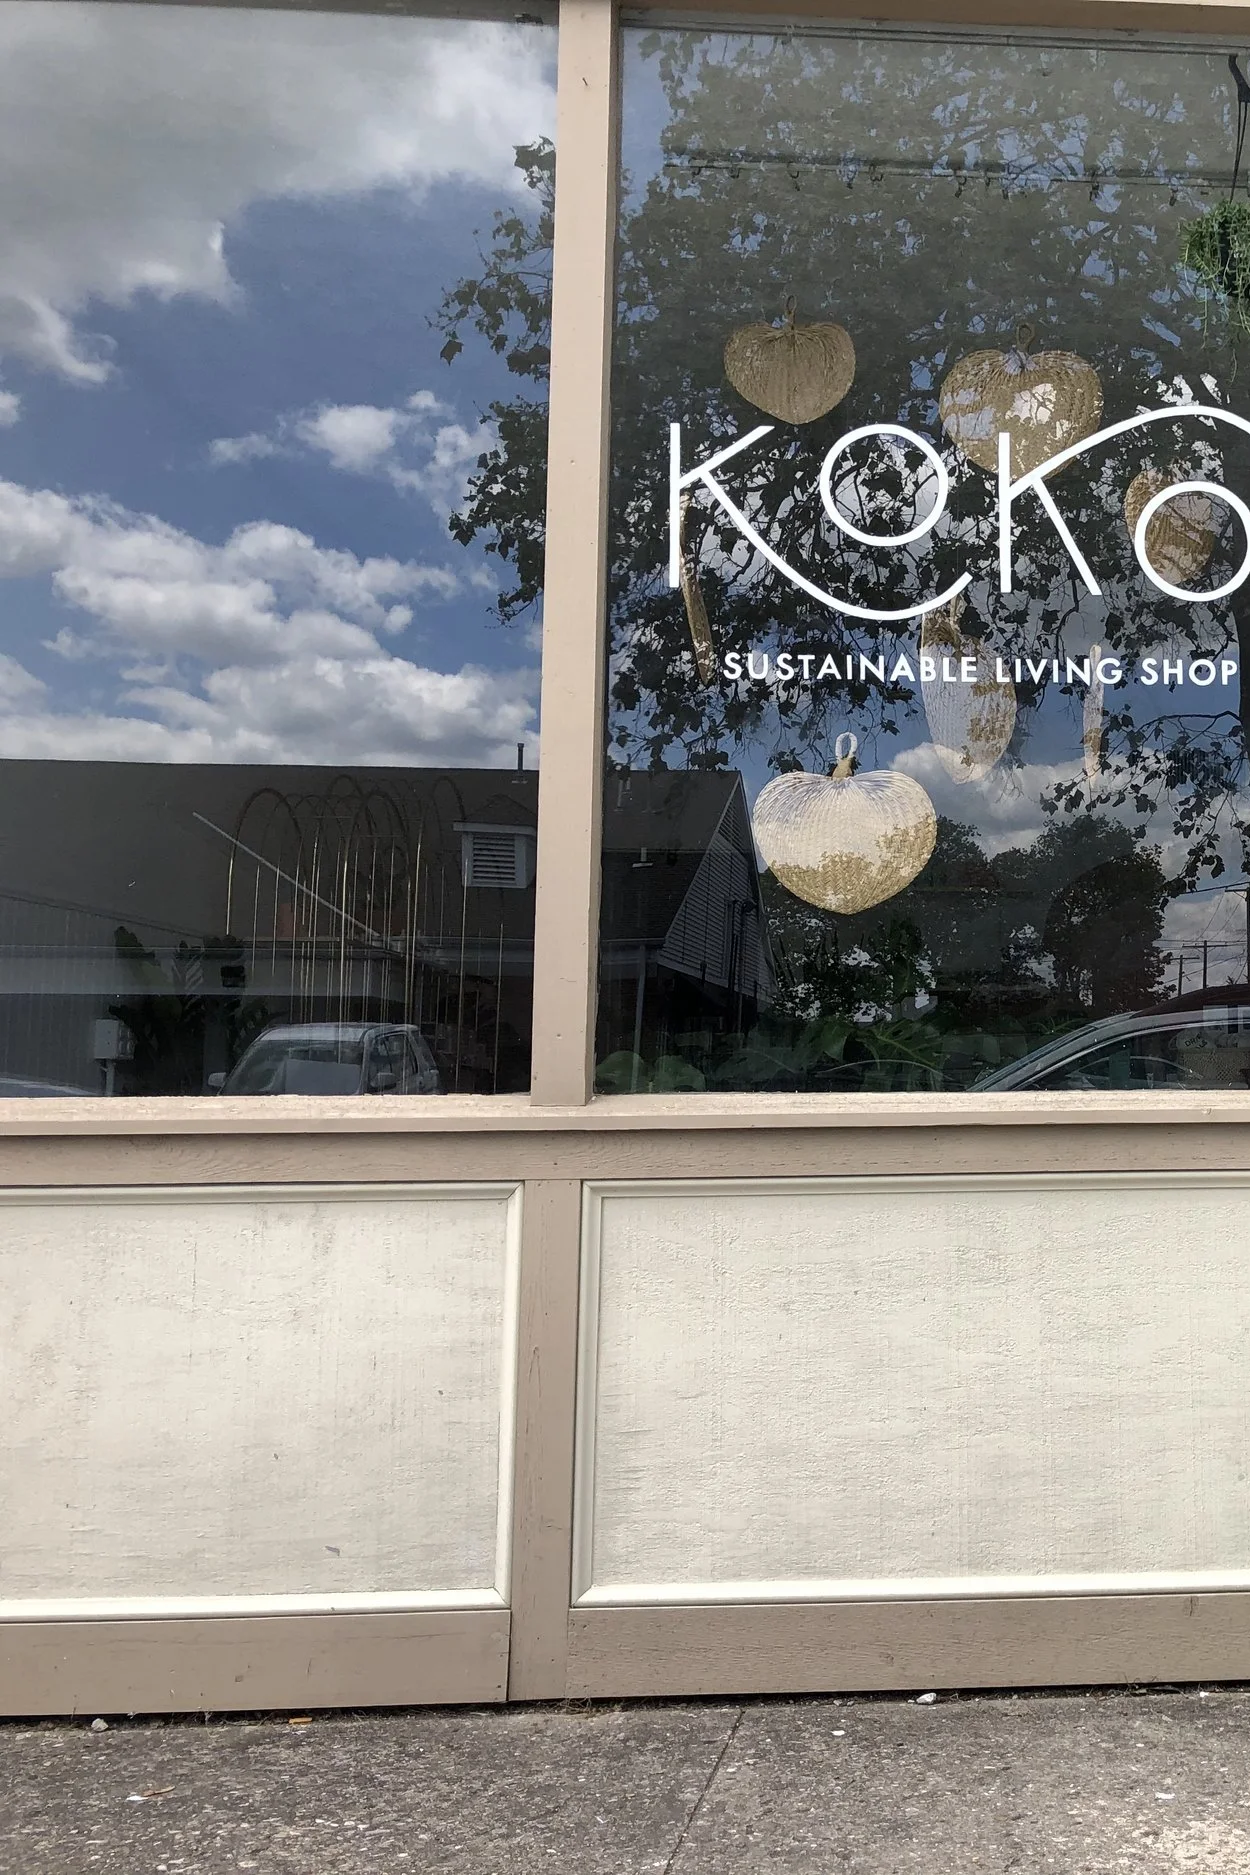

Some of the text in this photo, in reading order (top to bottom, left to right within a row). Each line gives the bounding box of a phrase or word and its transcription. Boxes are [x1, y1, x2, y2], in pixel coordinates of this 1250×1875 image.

[722, 651, 1239, 687] SUSTAINABLE LIVING SHOP
